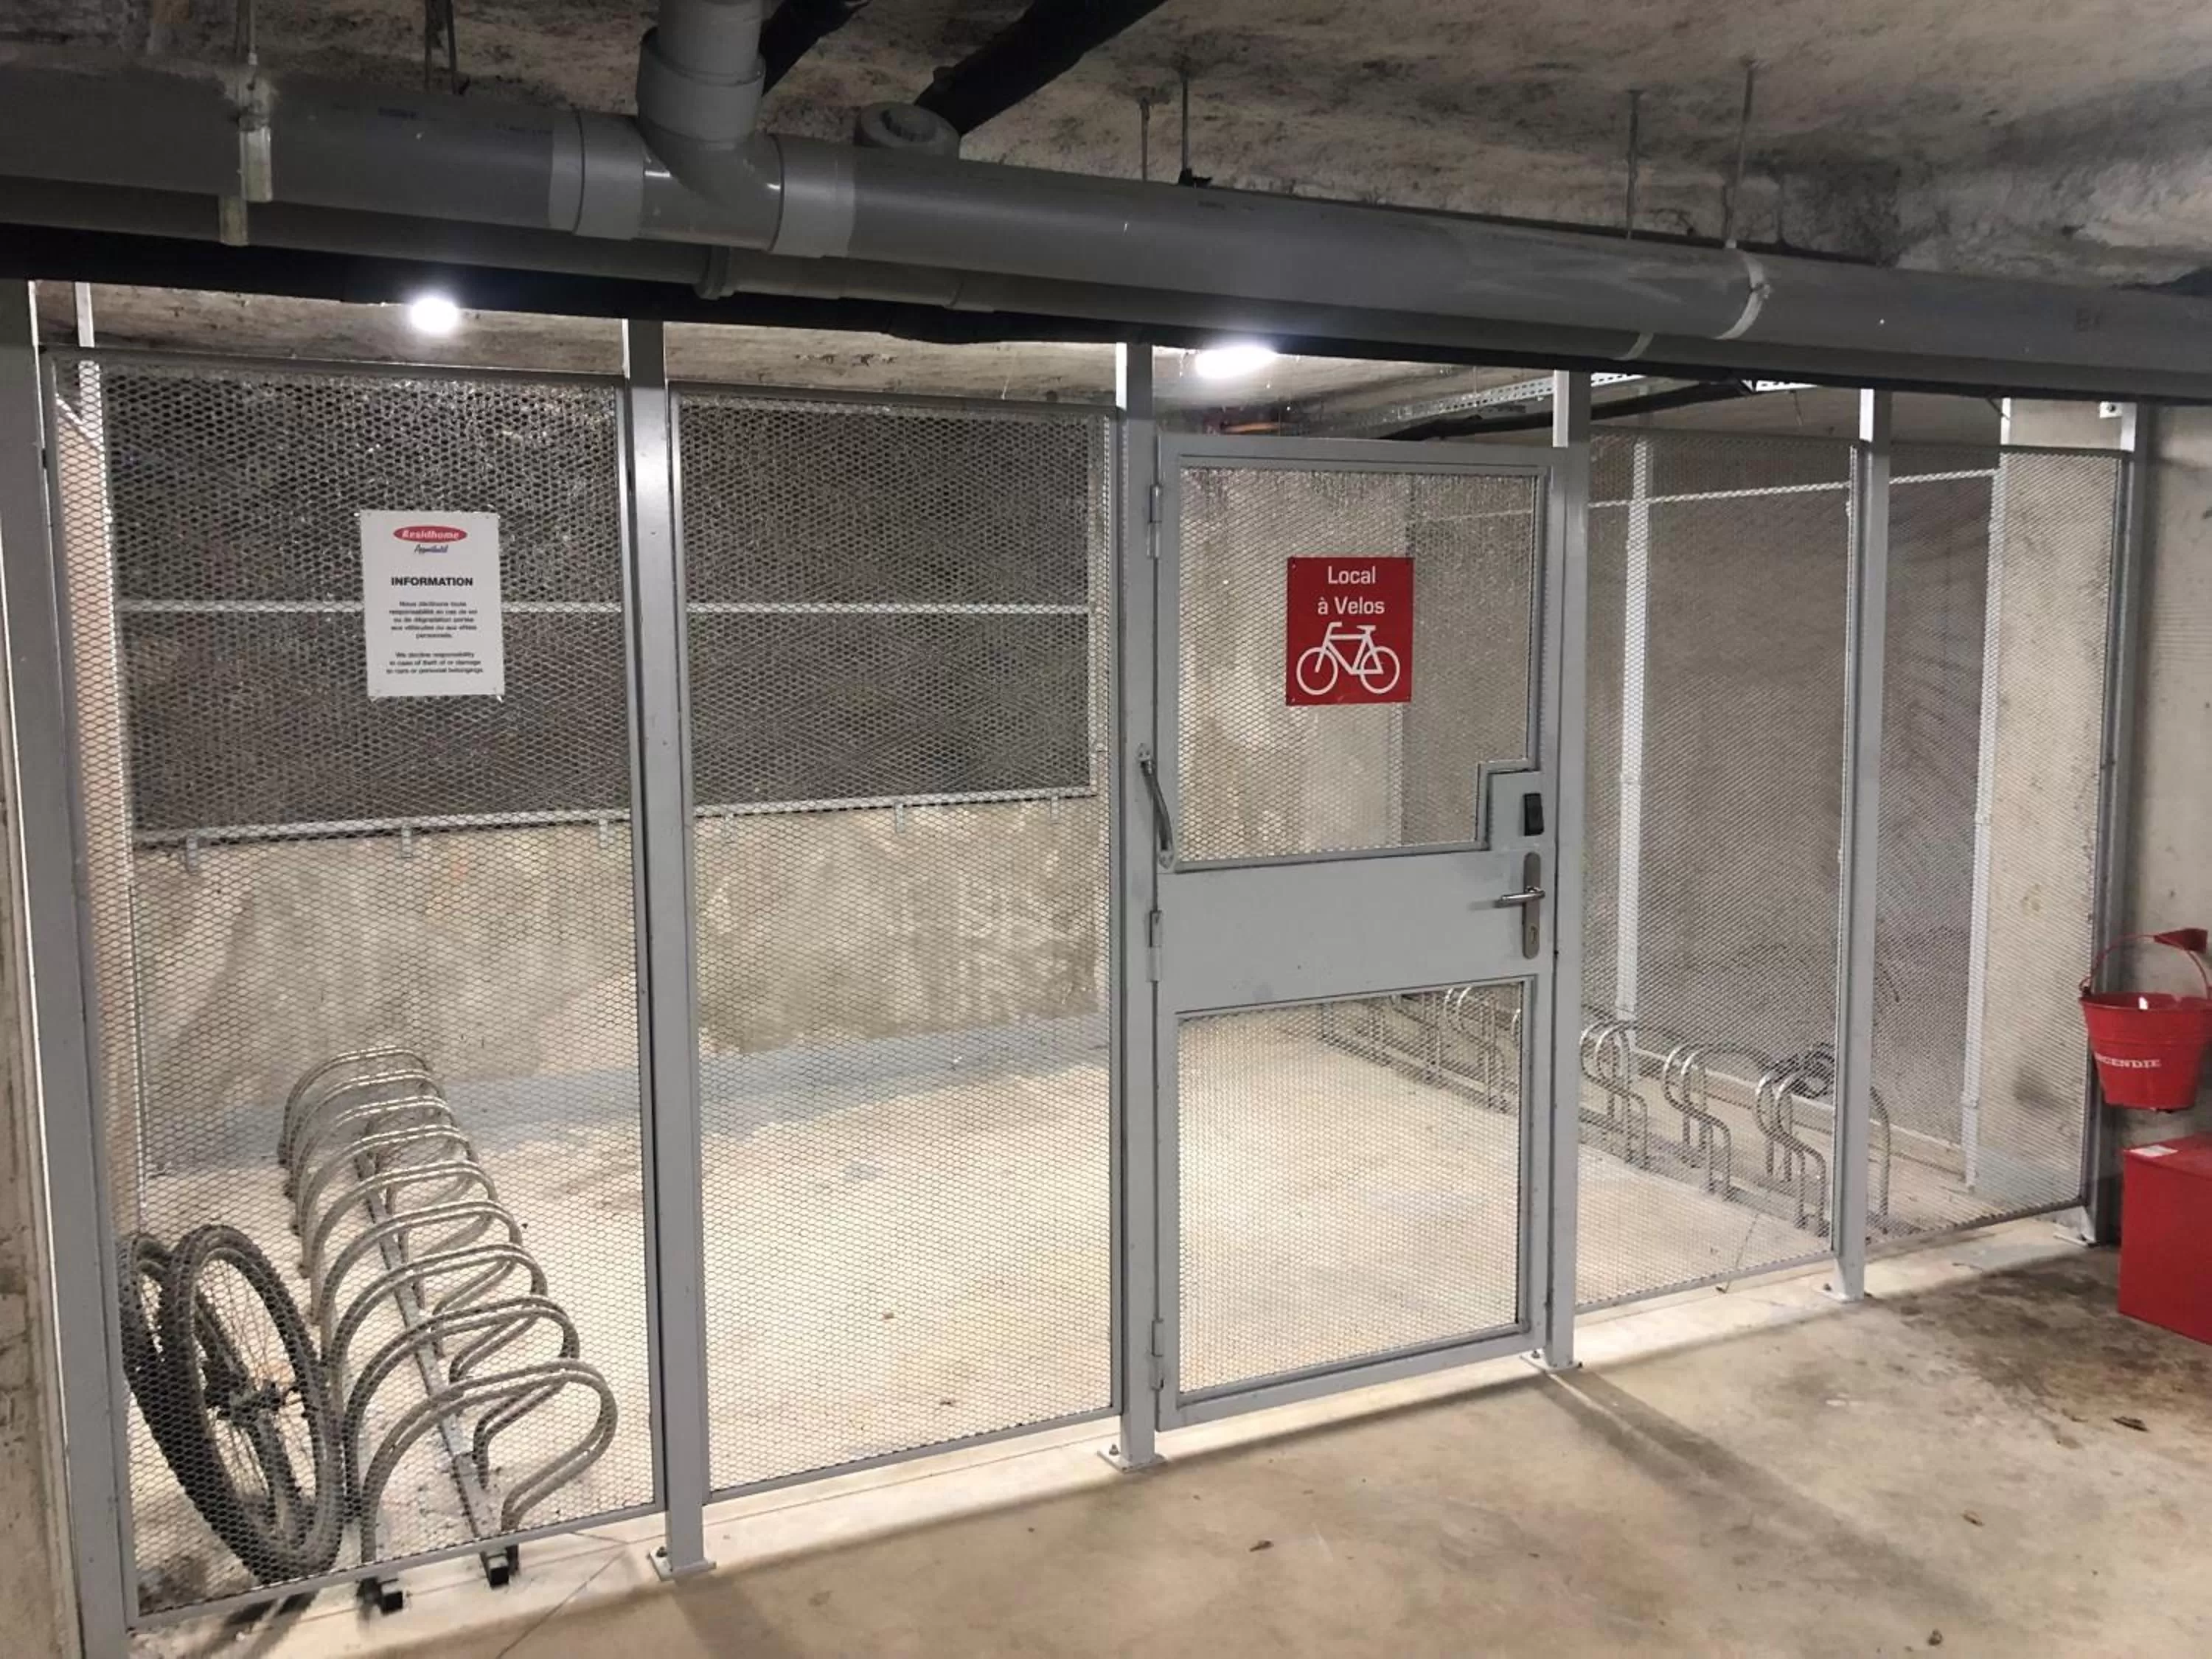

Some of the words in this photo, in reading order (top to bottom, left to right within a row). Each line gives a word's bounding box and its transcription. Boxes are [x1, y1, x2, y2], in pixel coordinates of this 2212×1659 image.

[391, 577, 473, 586] INFORMATION
[1327, 566, 1376, 584] Local
[1317, 596, 1329, 615] à
[1334, 596, 1385, 615] Velos
